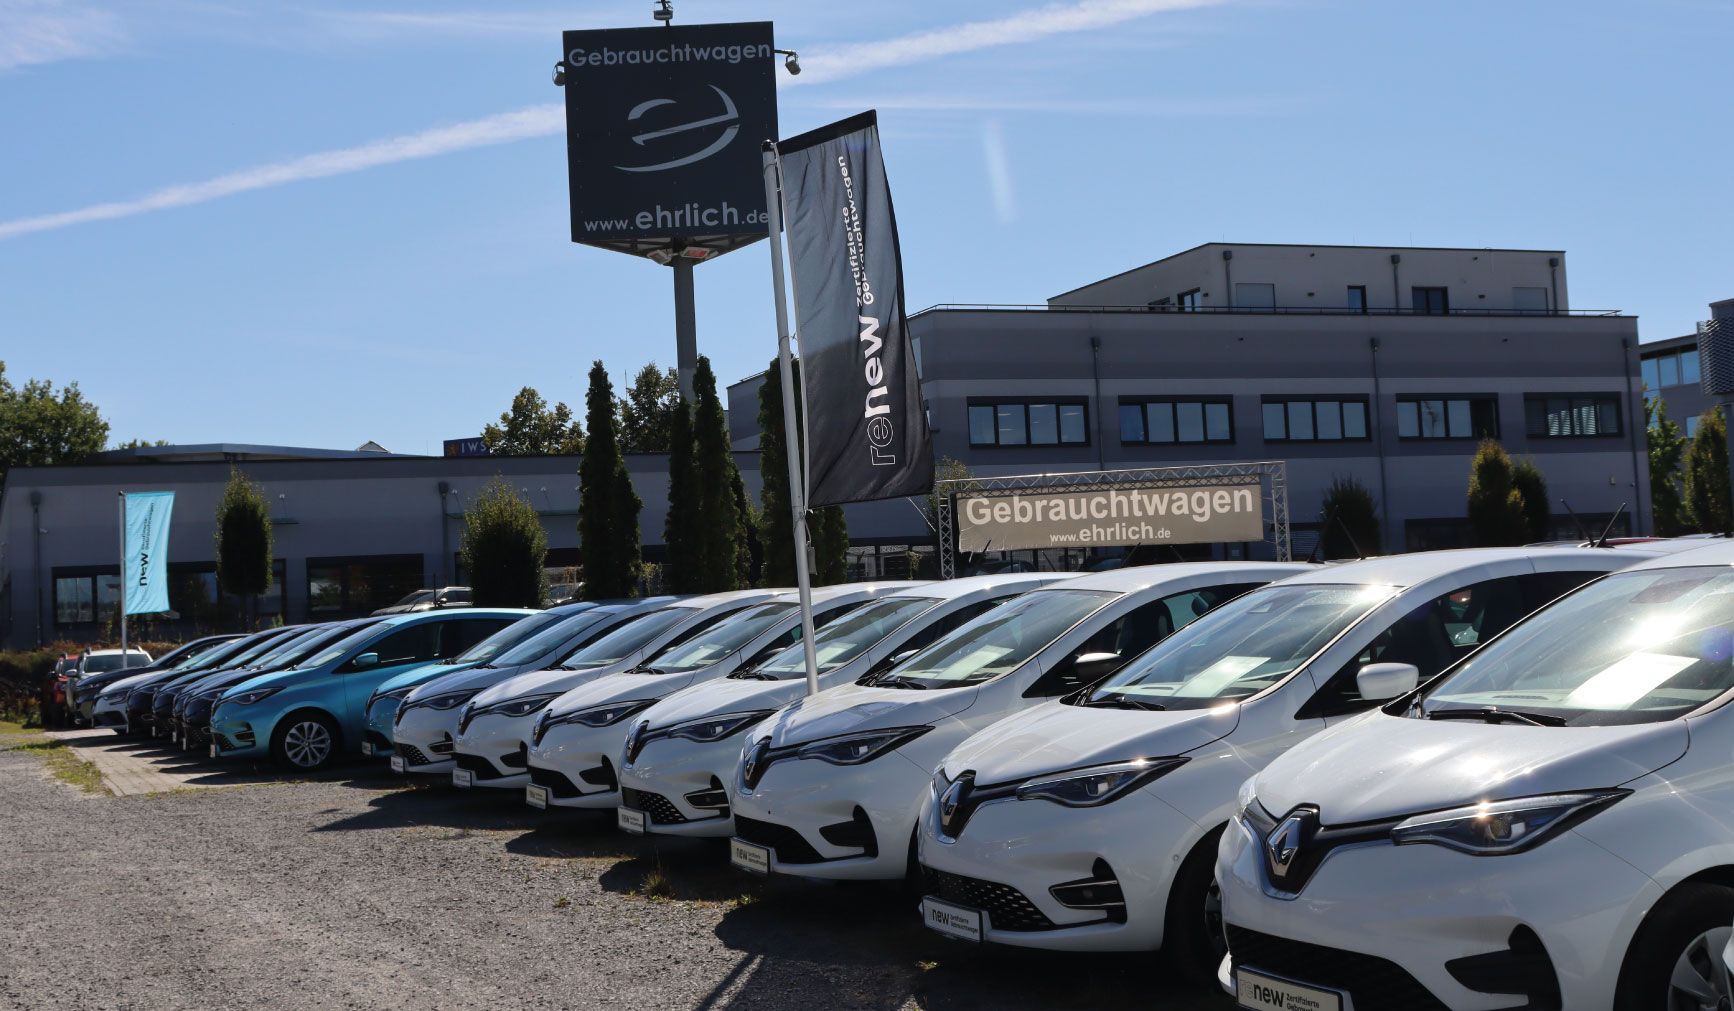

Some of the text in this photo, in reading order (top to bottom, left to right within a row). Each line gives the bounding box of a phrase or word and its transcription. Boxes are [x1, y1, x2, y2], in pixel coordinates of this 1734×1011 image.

[568, 43, 771, 67] Gebrauchtwagen
[584, 201, 769, 231] www.ehrlich.de
[858, 314, 896, 466] renew
[966, 487, 1253, 526] Gebrauchtwagen
[1050, 522, 1171, 544] www.ehrlich.de
